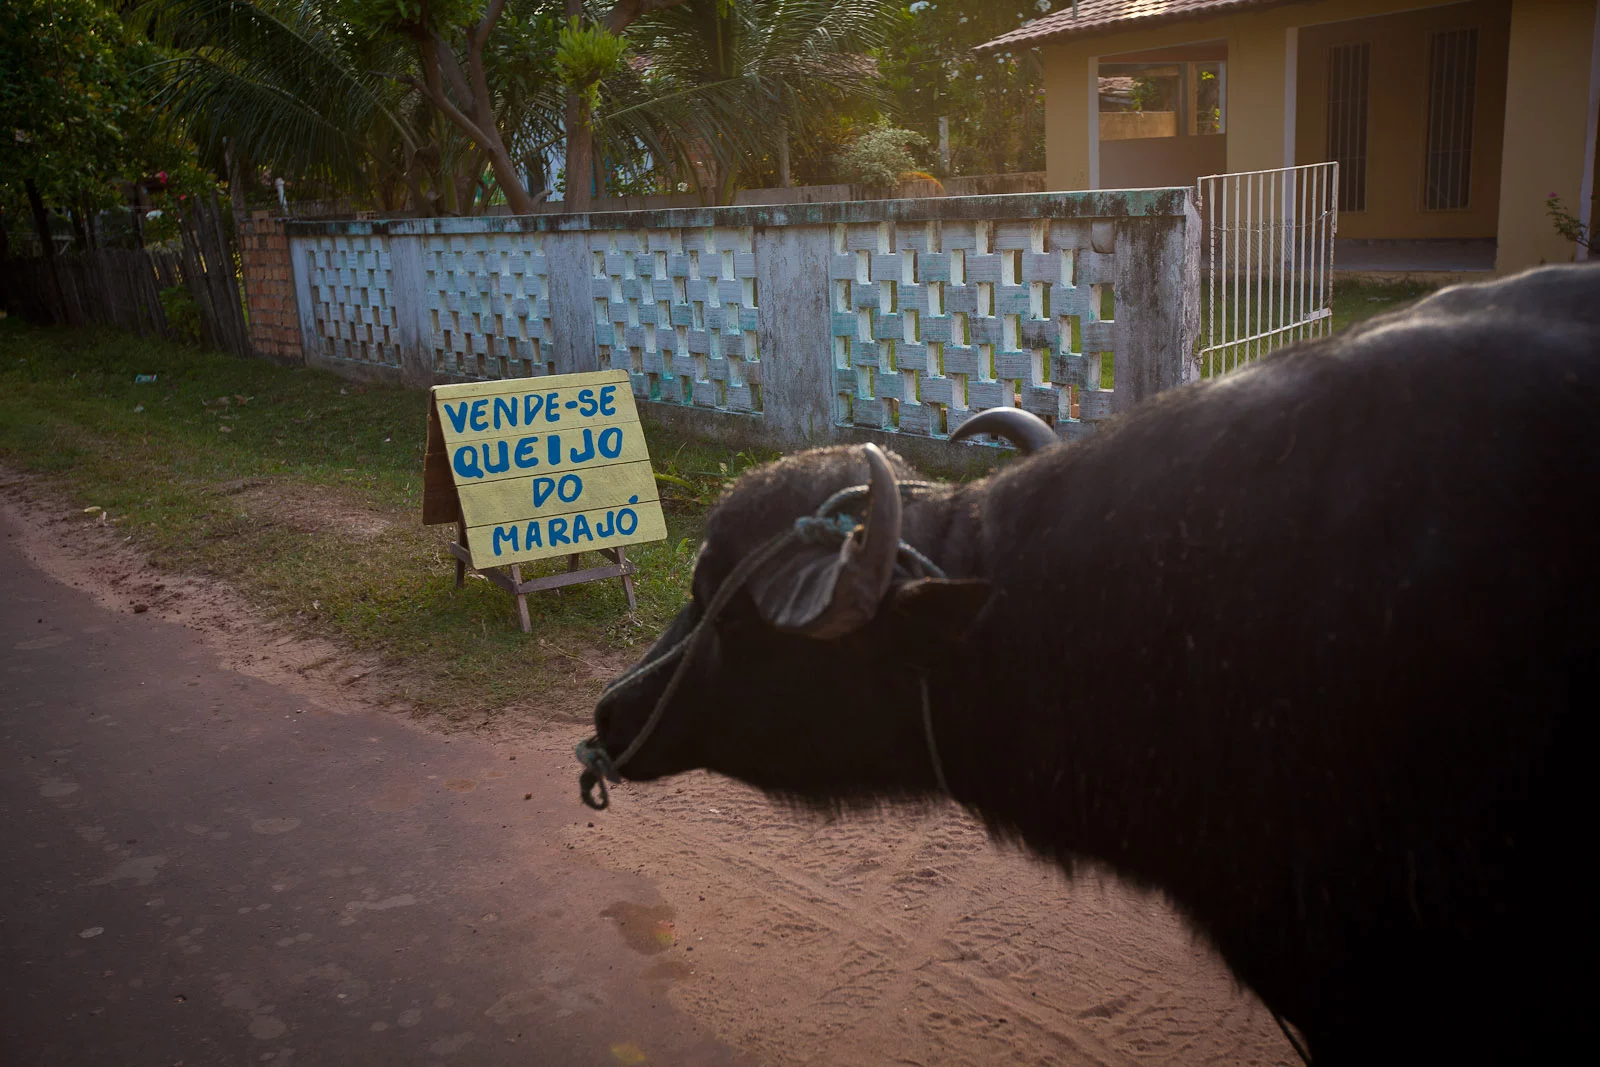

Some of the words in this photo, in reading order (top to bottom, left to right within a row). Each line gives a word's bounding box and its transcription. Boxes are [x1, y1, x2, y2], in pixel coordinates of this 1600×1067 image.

[444, 385, 617, 433] VENDE-SE
[453, 427, 623, 479] QUEIJO
[533, 474, 583, 508] DO
[492, 495, 639, 556] MARAJÓ
